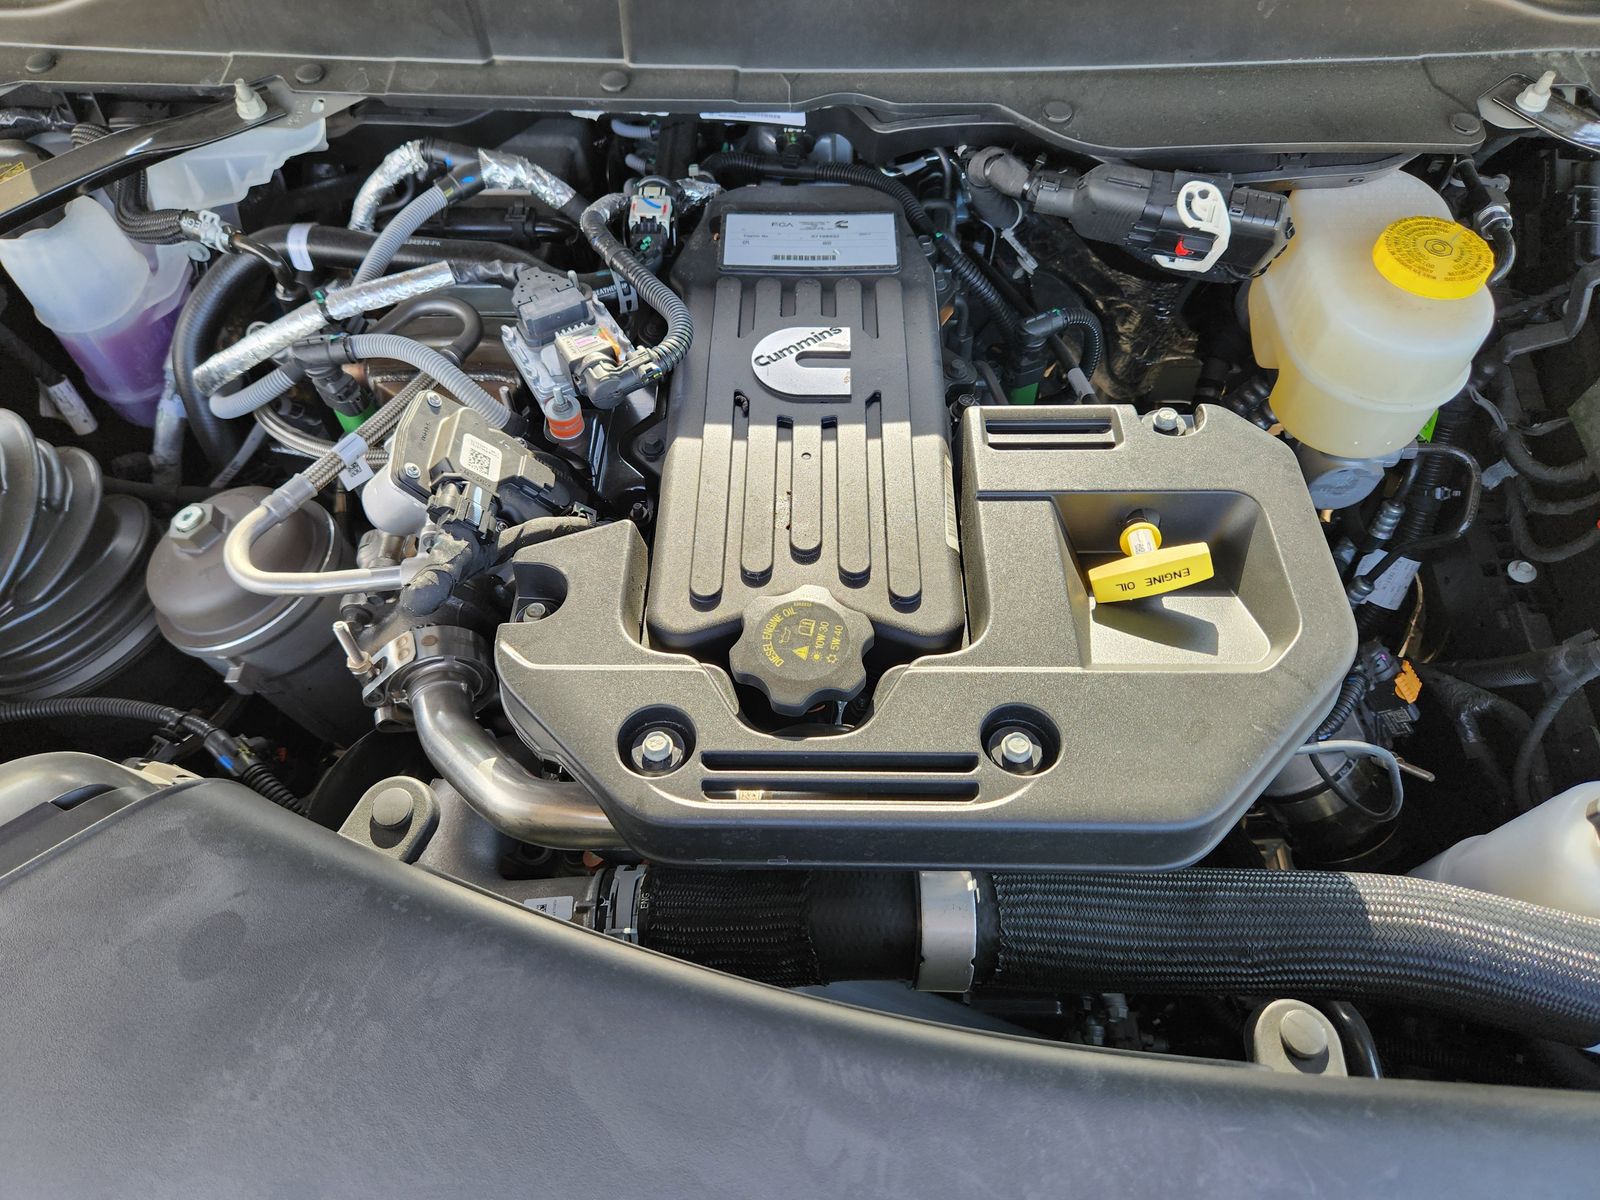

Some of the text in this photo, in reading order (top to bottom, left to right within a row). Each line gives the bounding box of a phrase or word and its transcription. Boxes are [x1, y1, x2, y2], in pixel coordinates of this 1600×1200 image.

[753, 326, 842, 367] Cummins
[1115, 567, 1191, 592] ENGINE OIL
[762, 606, 798, 667] DIESEL ENGINE OIL
[815, 621, 830, 649] 10W-30
[830, 625, 844, 651] 5W-40
[640, 892, 650, 909] ENG
